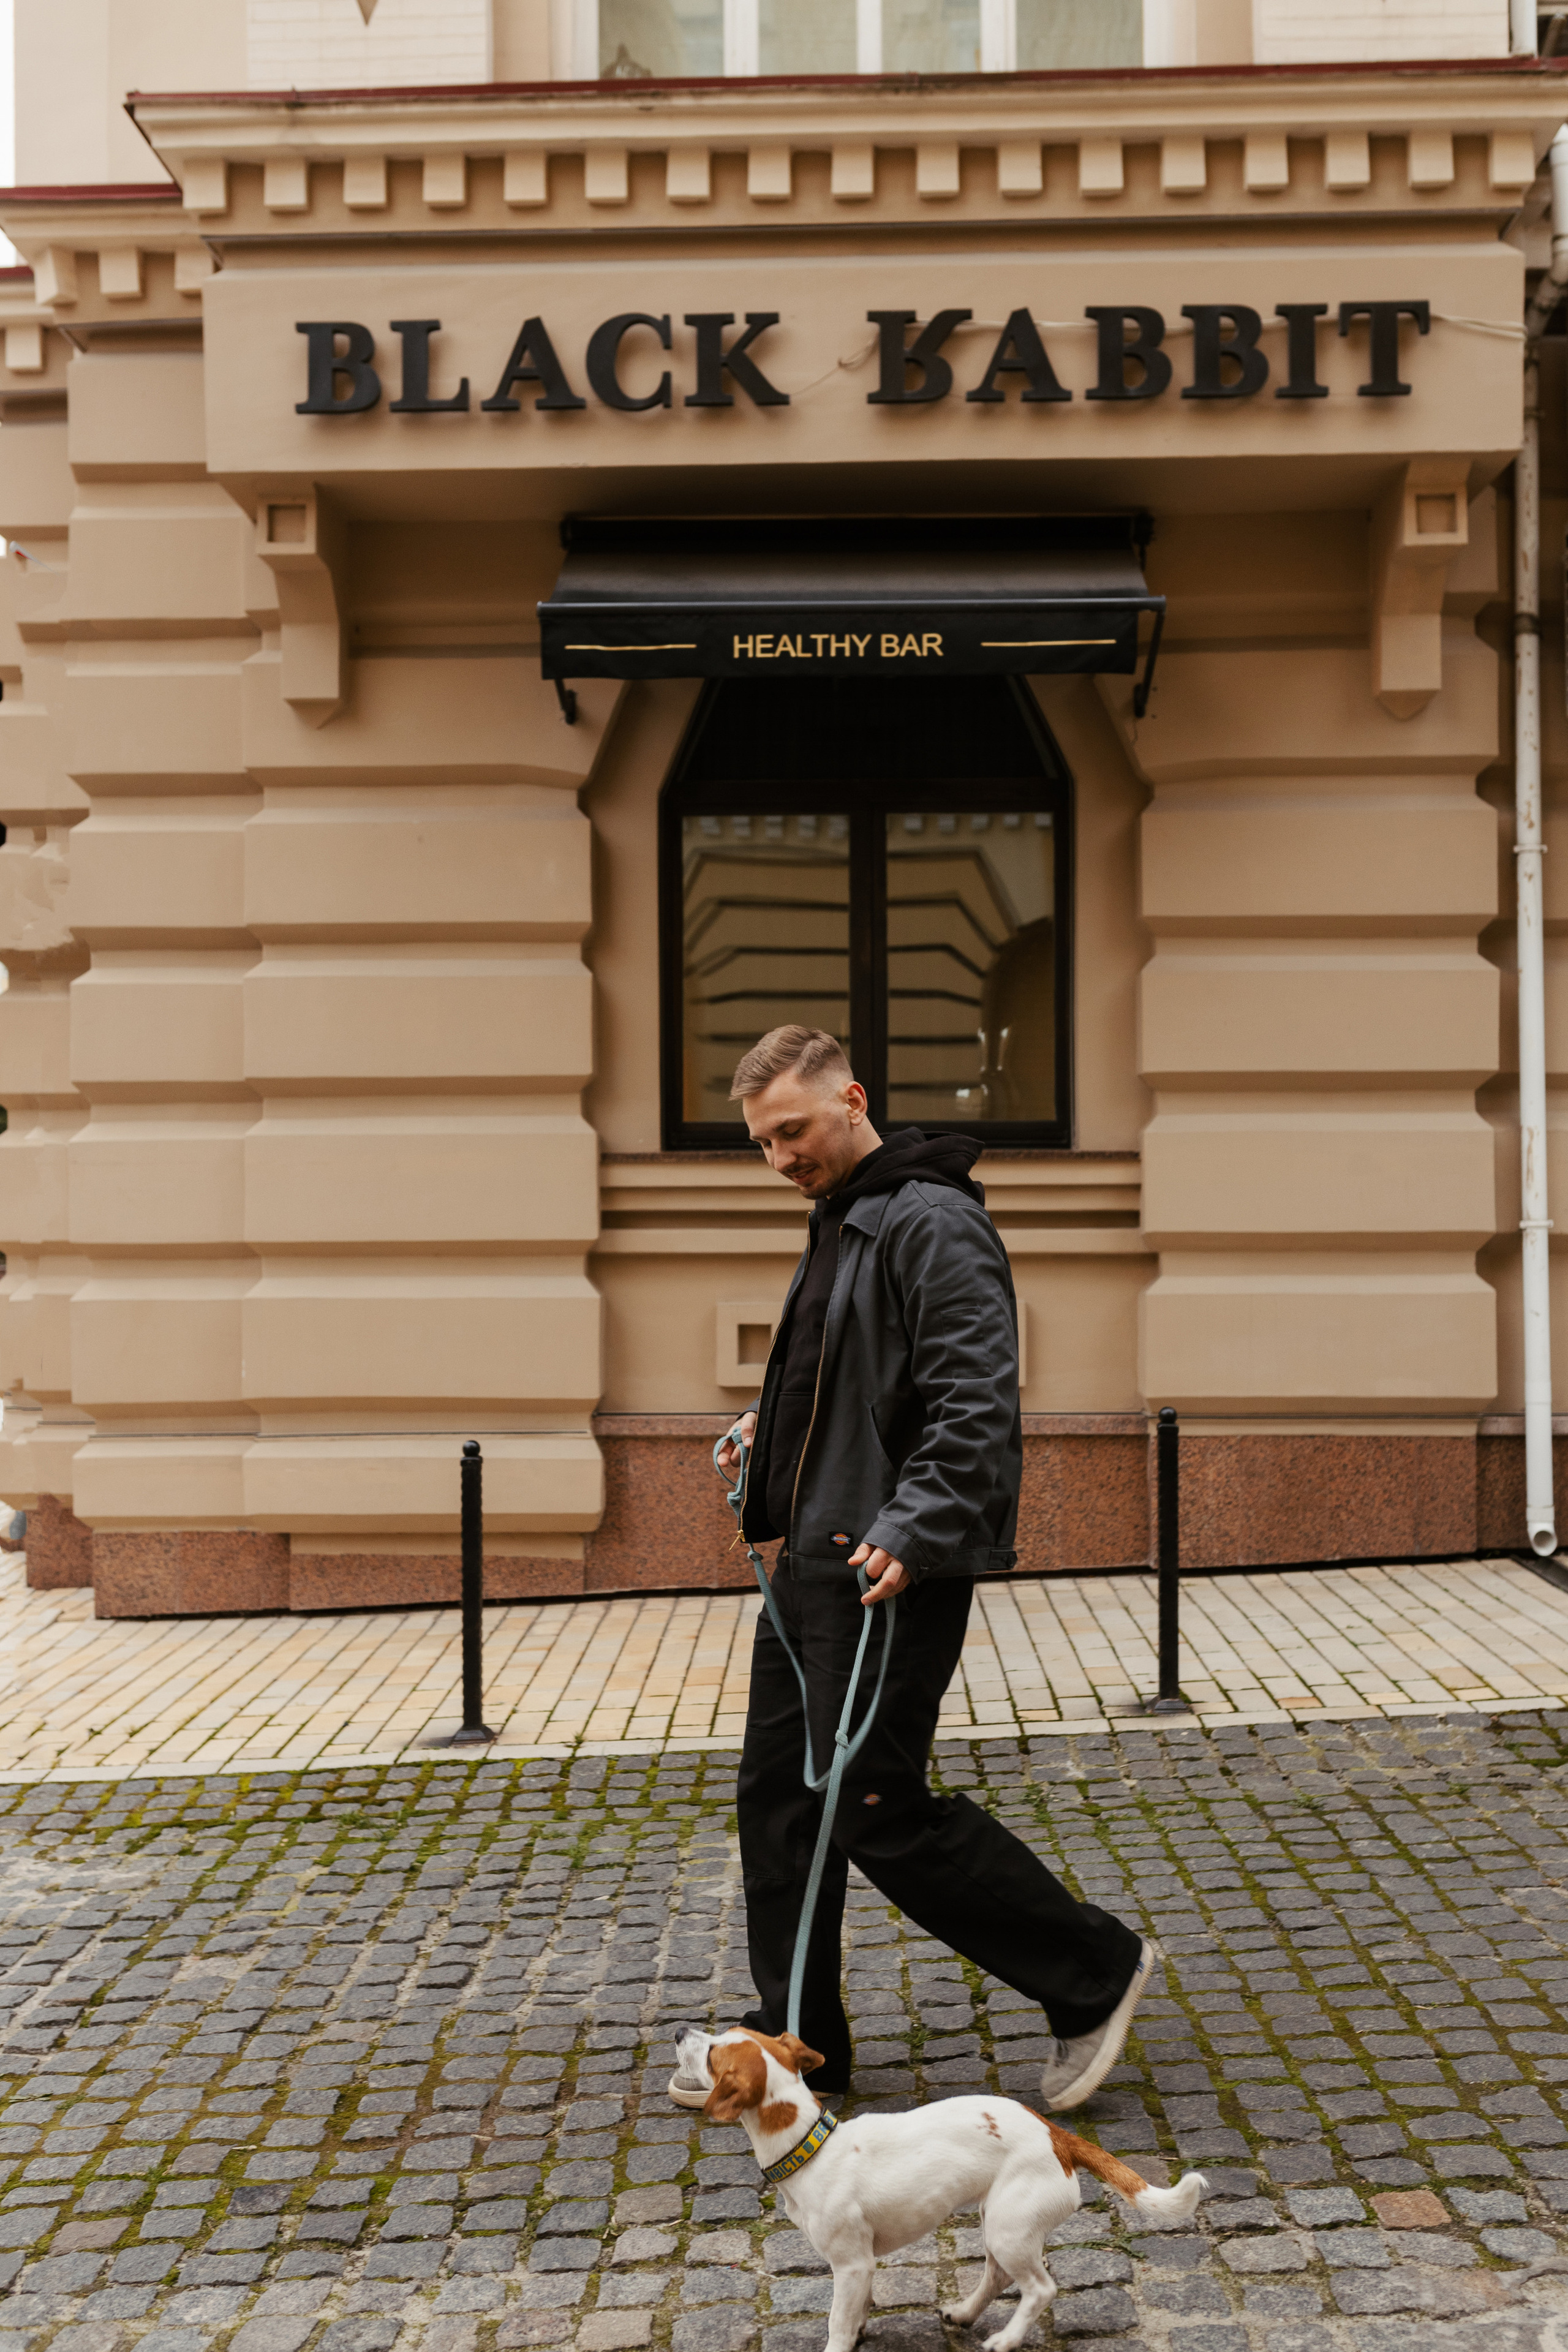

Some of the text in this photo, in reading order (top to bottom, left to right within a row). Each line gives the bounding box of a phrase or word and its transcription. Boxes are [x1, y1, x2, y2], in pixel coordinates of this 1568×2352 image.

[296, 313, 790, 415] BLACK
[733, 633, 943, 658] HEALTHY BAR
[766, 2154, 805, 2180] ИВІСТЬ
